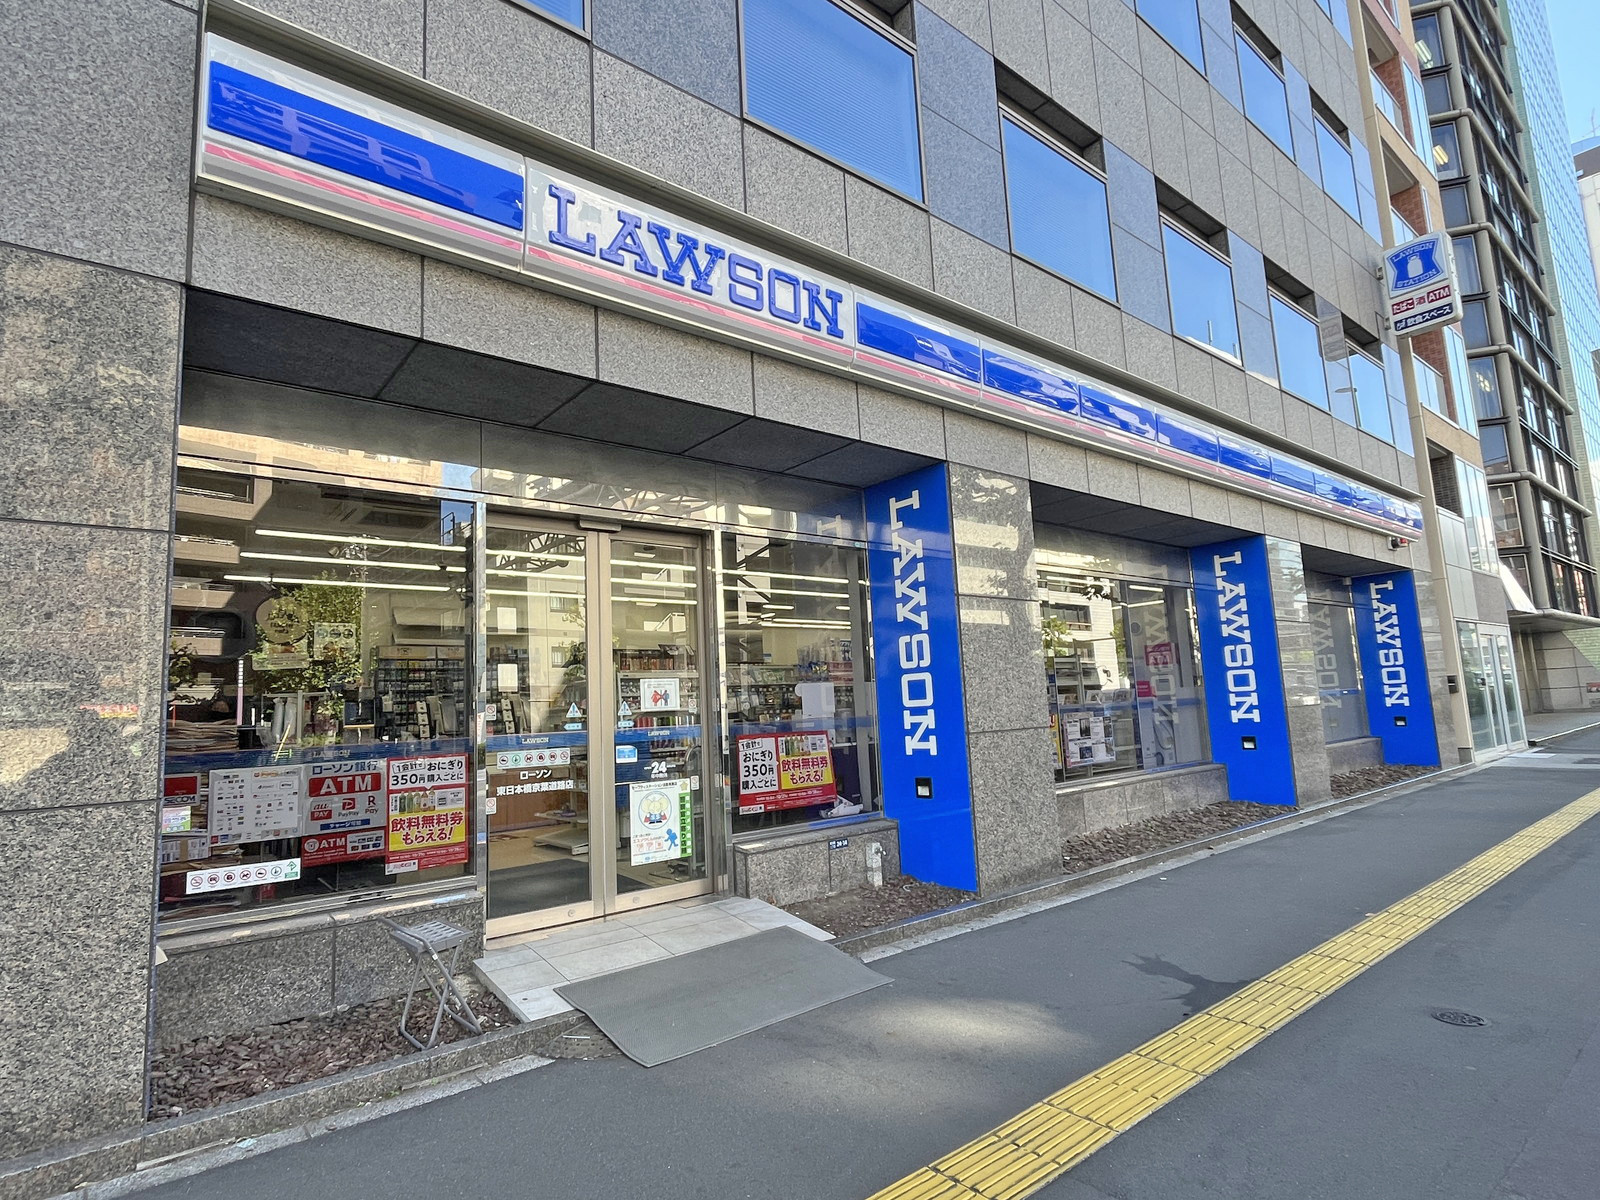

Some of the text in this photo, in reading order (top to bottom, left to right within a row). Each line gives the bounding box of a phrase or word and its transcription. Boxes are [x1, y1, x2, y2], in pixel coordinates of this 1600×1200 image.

[1392, 242, 1433, 262] LAWSON
[548, 184, 844, 337] LAWSON
[1397, 269, 1437, 288] STATION
[1393, 299, 1414, 314] たばこ
[1428, 287, 1450, 302] ATM
[1407, 305, 1452, 326] 飲食スペース
[889, 489, 938, 757] LAWSON
[1213, 550, 1261, 725] LAWSON
[1369, 580, 1410, 708] LAWSON
[742, 749, 773, 763] おにぎり
[312, 761, 378, 775] ローソン銀行
[396, 759, 463, 773] 1会計で おにぎり
[651, 762, 667, 774] 24
[743, 764, 775, 778] 350円
[781, 756, 828, 772] 飲料無料券
[392, 771, 464, 786] 350円 購入ごとに
[519, 769, 552, 780] ローソン
[790, 770, 823, 785] もらえる!
[320, 775, 372, 795] ATM
[742, 776, 777, 790] 購入ごとに
[164, 795, 196, 804] SECOM
[337, 809, 359, 818] PayPay
[365, 807, 379, 815] Pay
[391, 811, 464, 832] 飲料無料券
[320, 837, 346, 849] ATM
[402, 827, 453, 845] もらえる!
